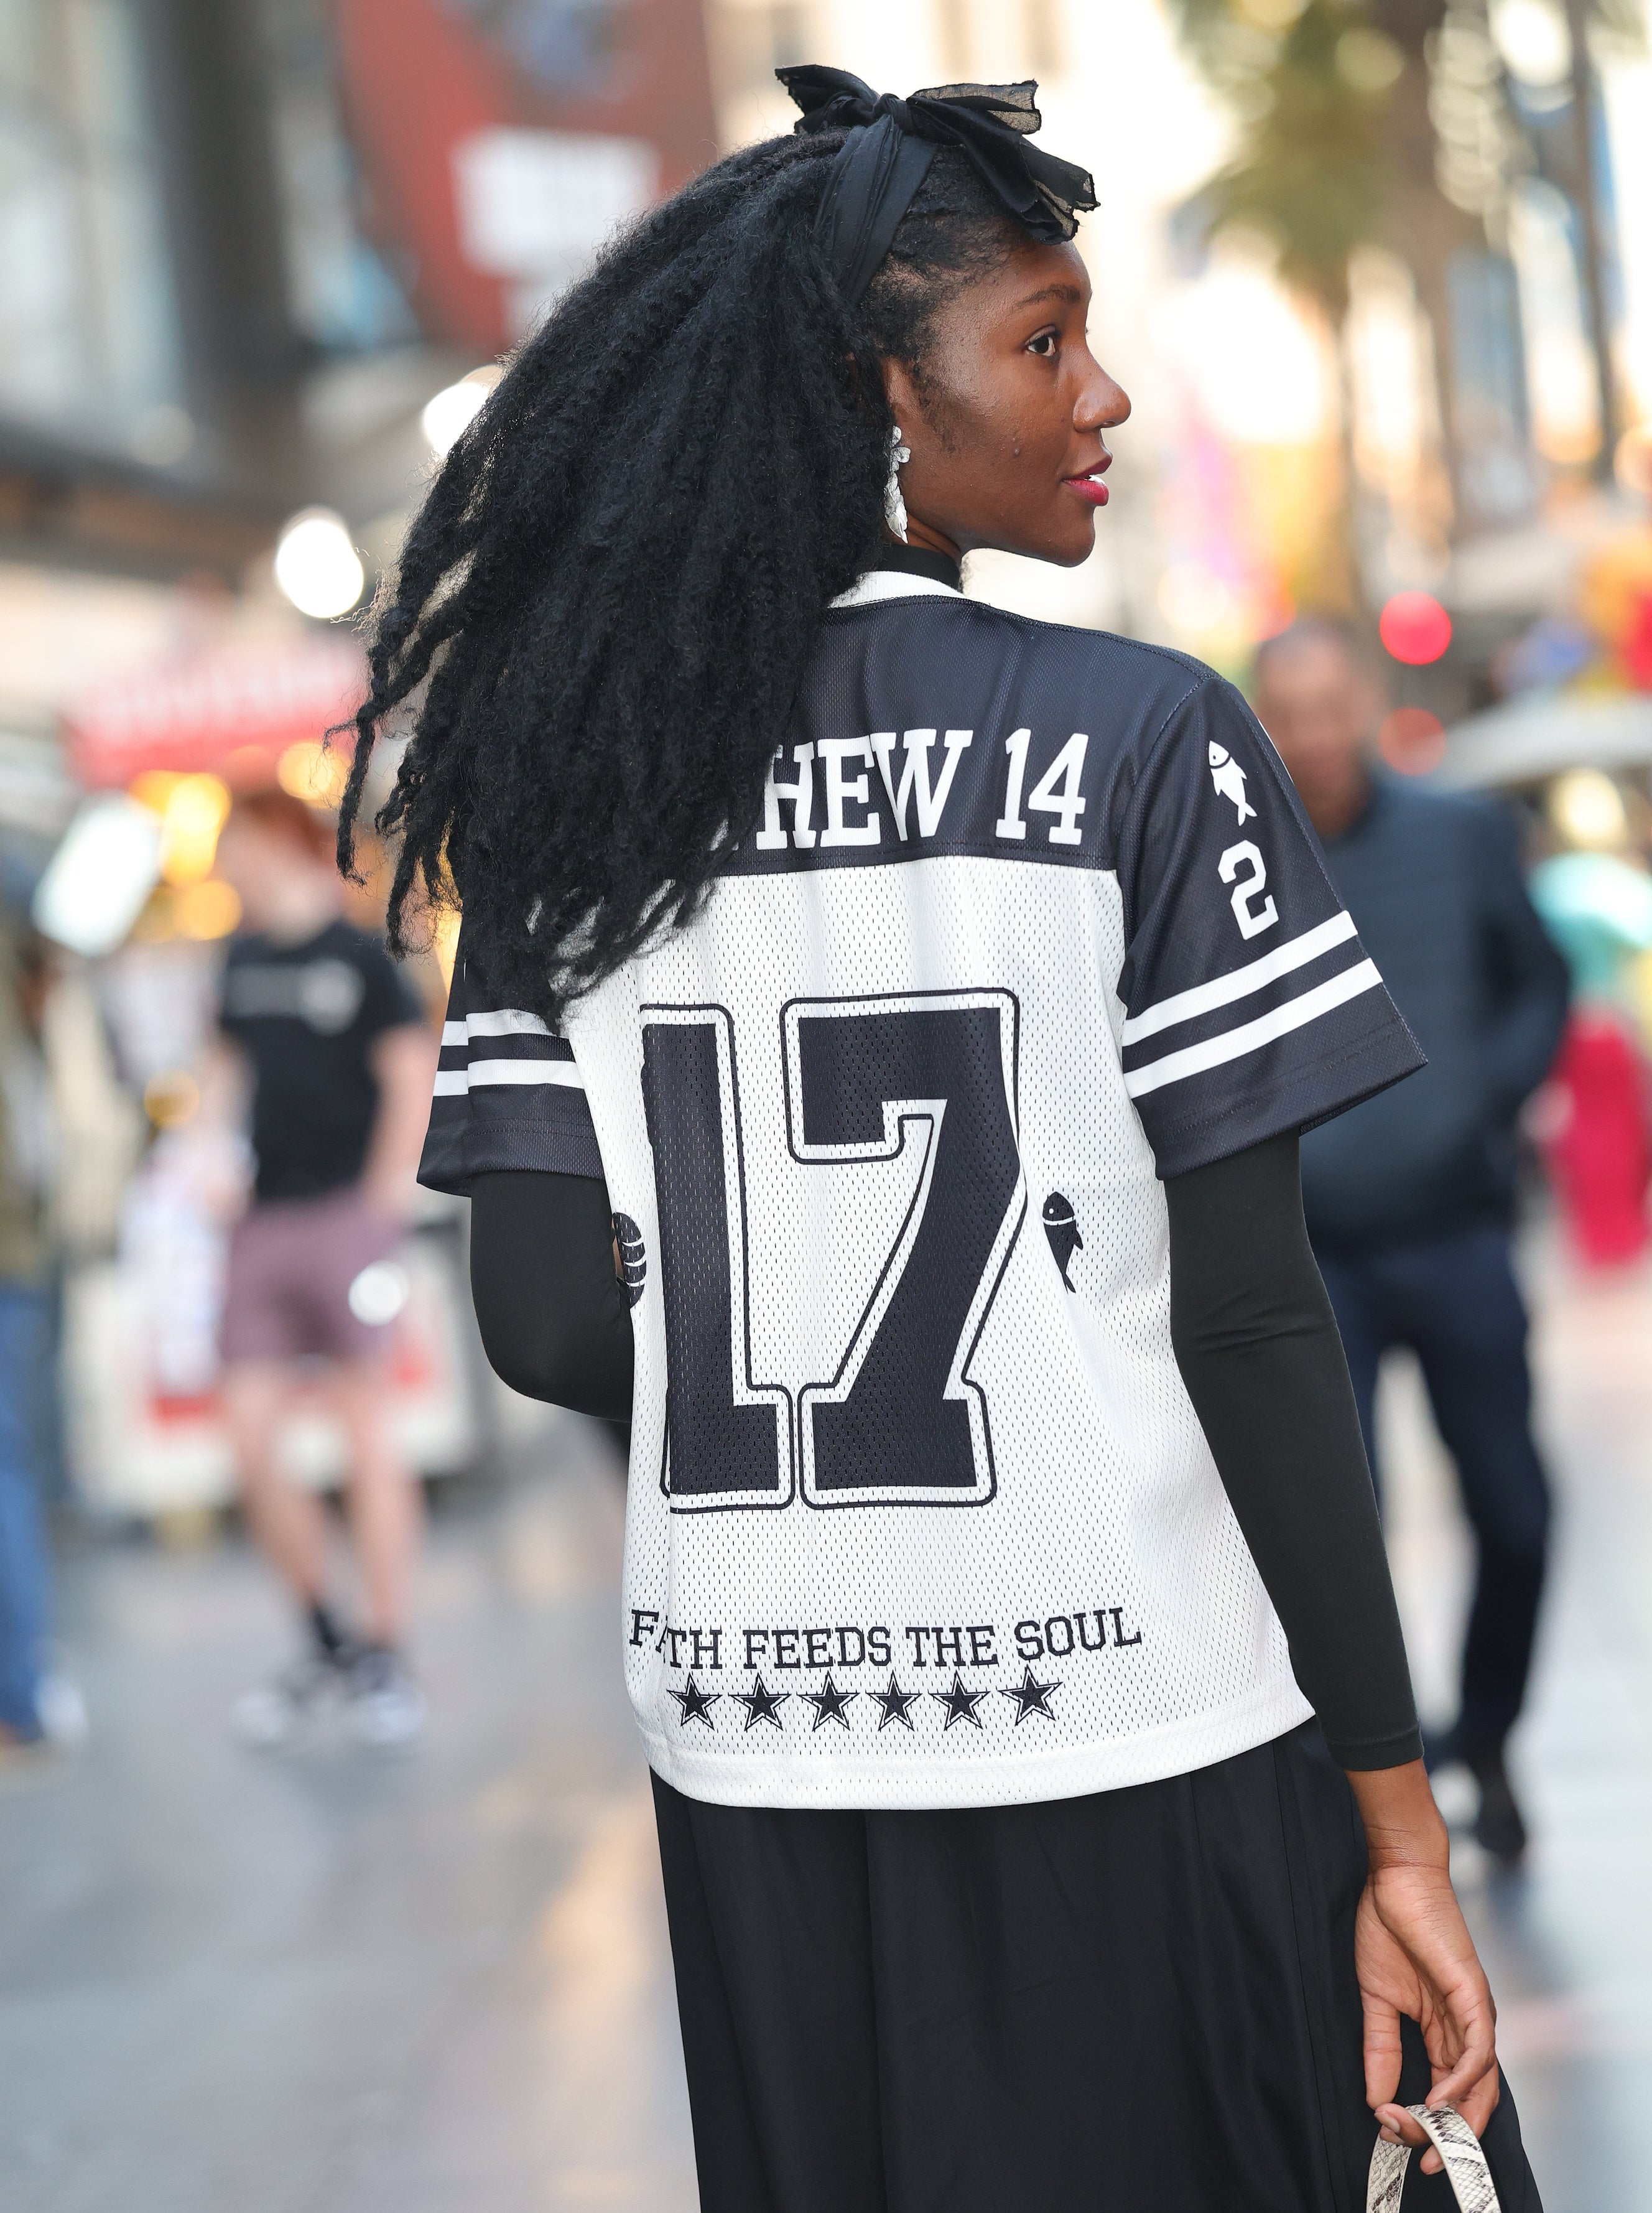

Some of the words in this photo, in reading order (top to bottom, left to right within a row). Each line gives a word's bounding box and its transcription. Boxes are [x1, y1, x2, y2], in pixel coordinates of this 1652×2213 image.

[708, 729, 973, 850] HEW
[995, 727, 1088, 846] 14
[1217, 839, 1279, 941] 2
[639, 986, 1028, 1514] 17
[629, 1608, 723, 1670] FTH
[742, 1626, 894, 1670] FEEDS
[905, 1625, 998, 1668] THE
[1015, 1606, 1143, 1661] SOUL
